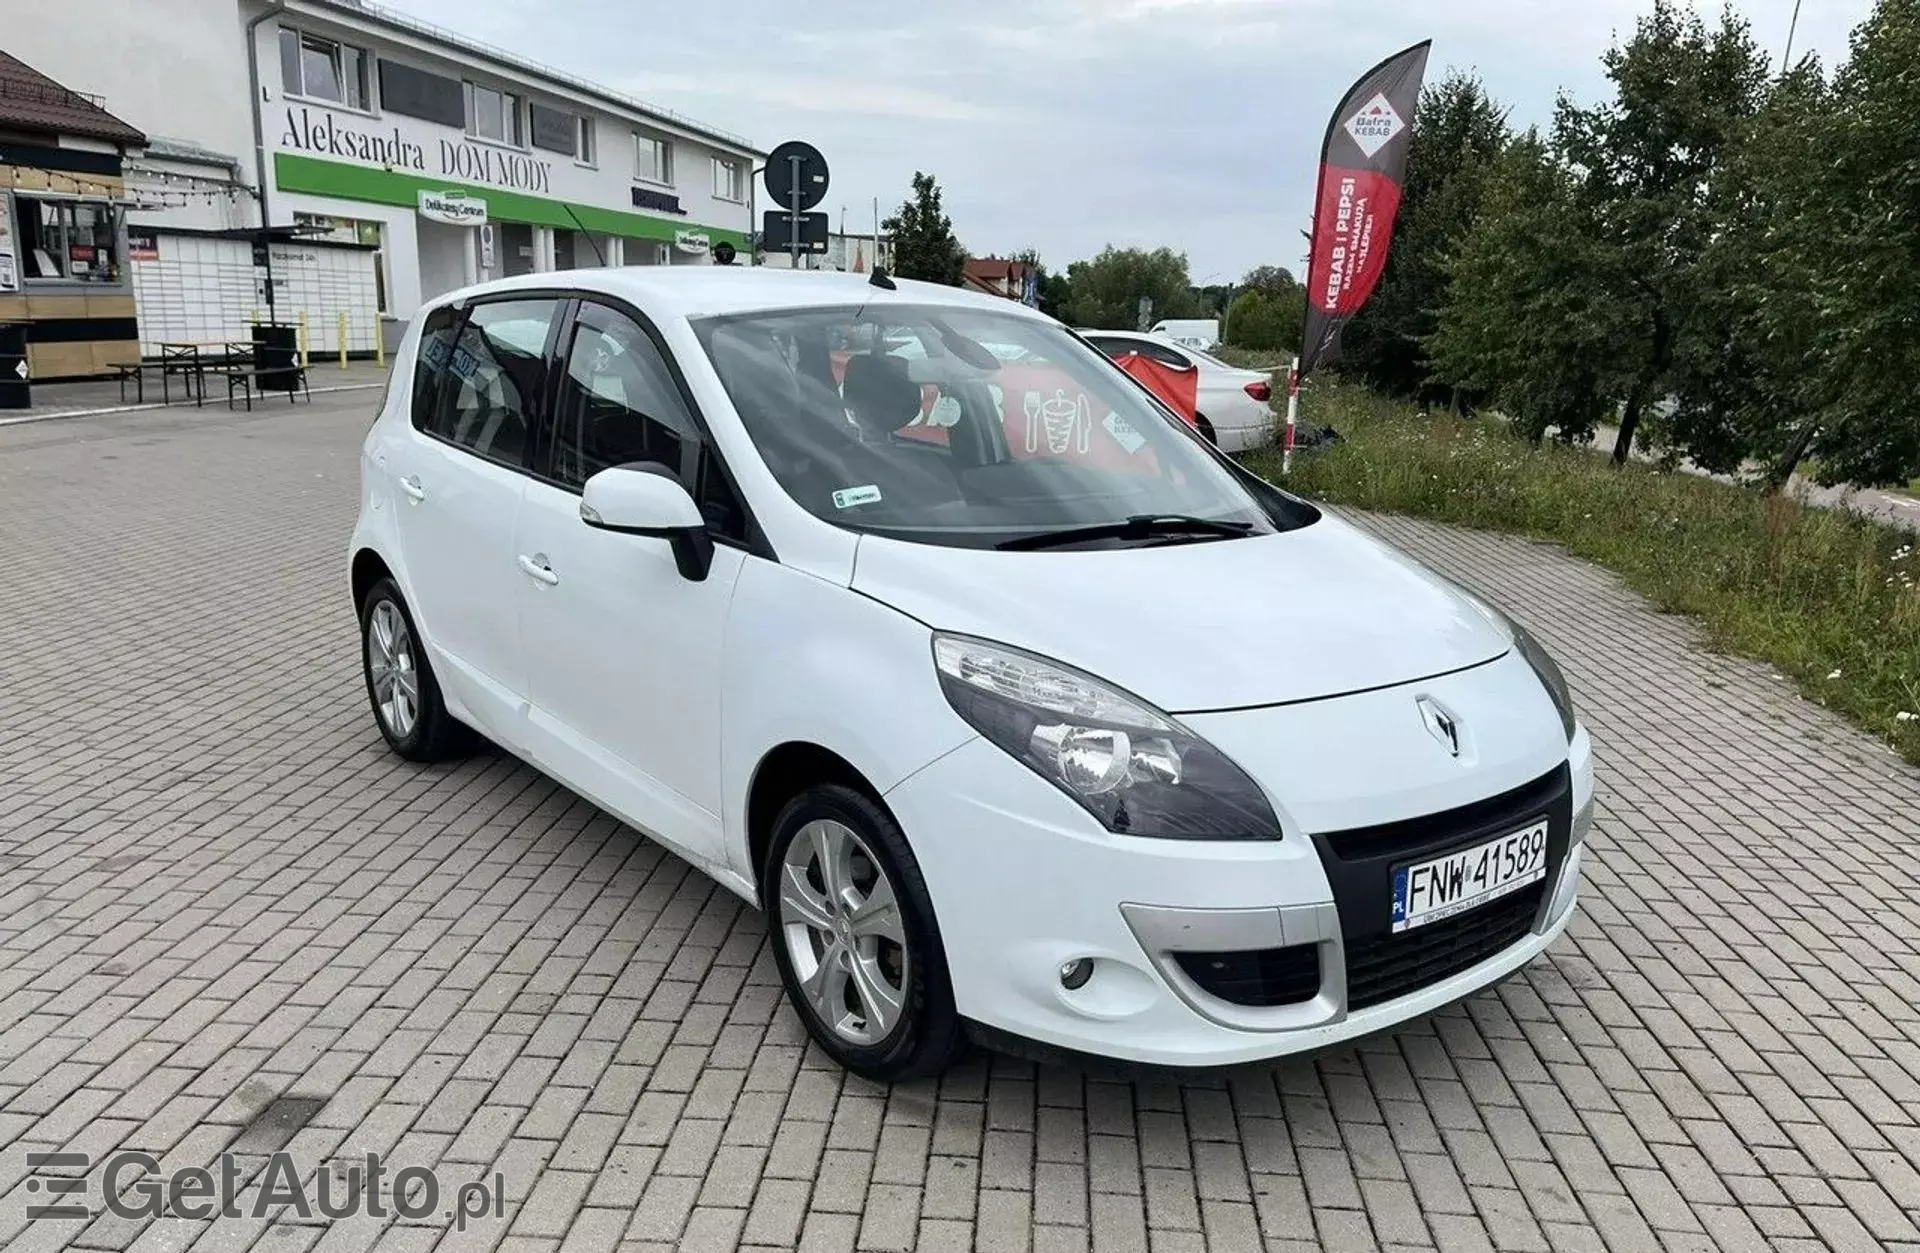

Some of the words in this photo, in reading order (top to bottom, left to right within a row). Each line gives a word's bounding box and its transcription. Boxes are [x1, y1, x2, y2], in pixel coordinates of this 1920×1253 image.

[281, 106, 425, 171] Aleksandra
[439, 139, 492, 182] DOM
[497, 151, 552, 194] MODY
[1354, 127, 1391, 137] KEBAB
[1335, 177, 1356, 233] PEPSI
[1325, 246, 1346, 309] KEBAB
[1409, 856, 1466, 913] FNW
[1473, 829, 1544, 889] 41589
[1392, 901, 1404, 915] PL
